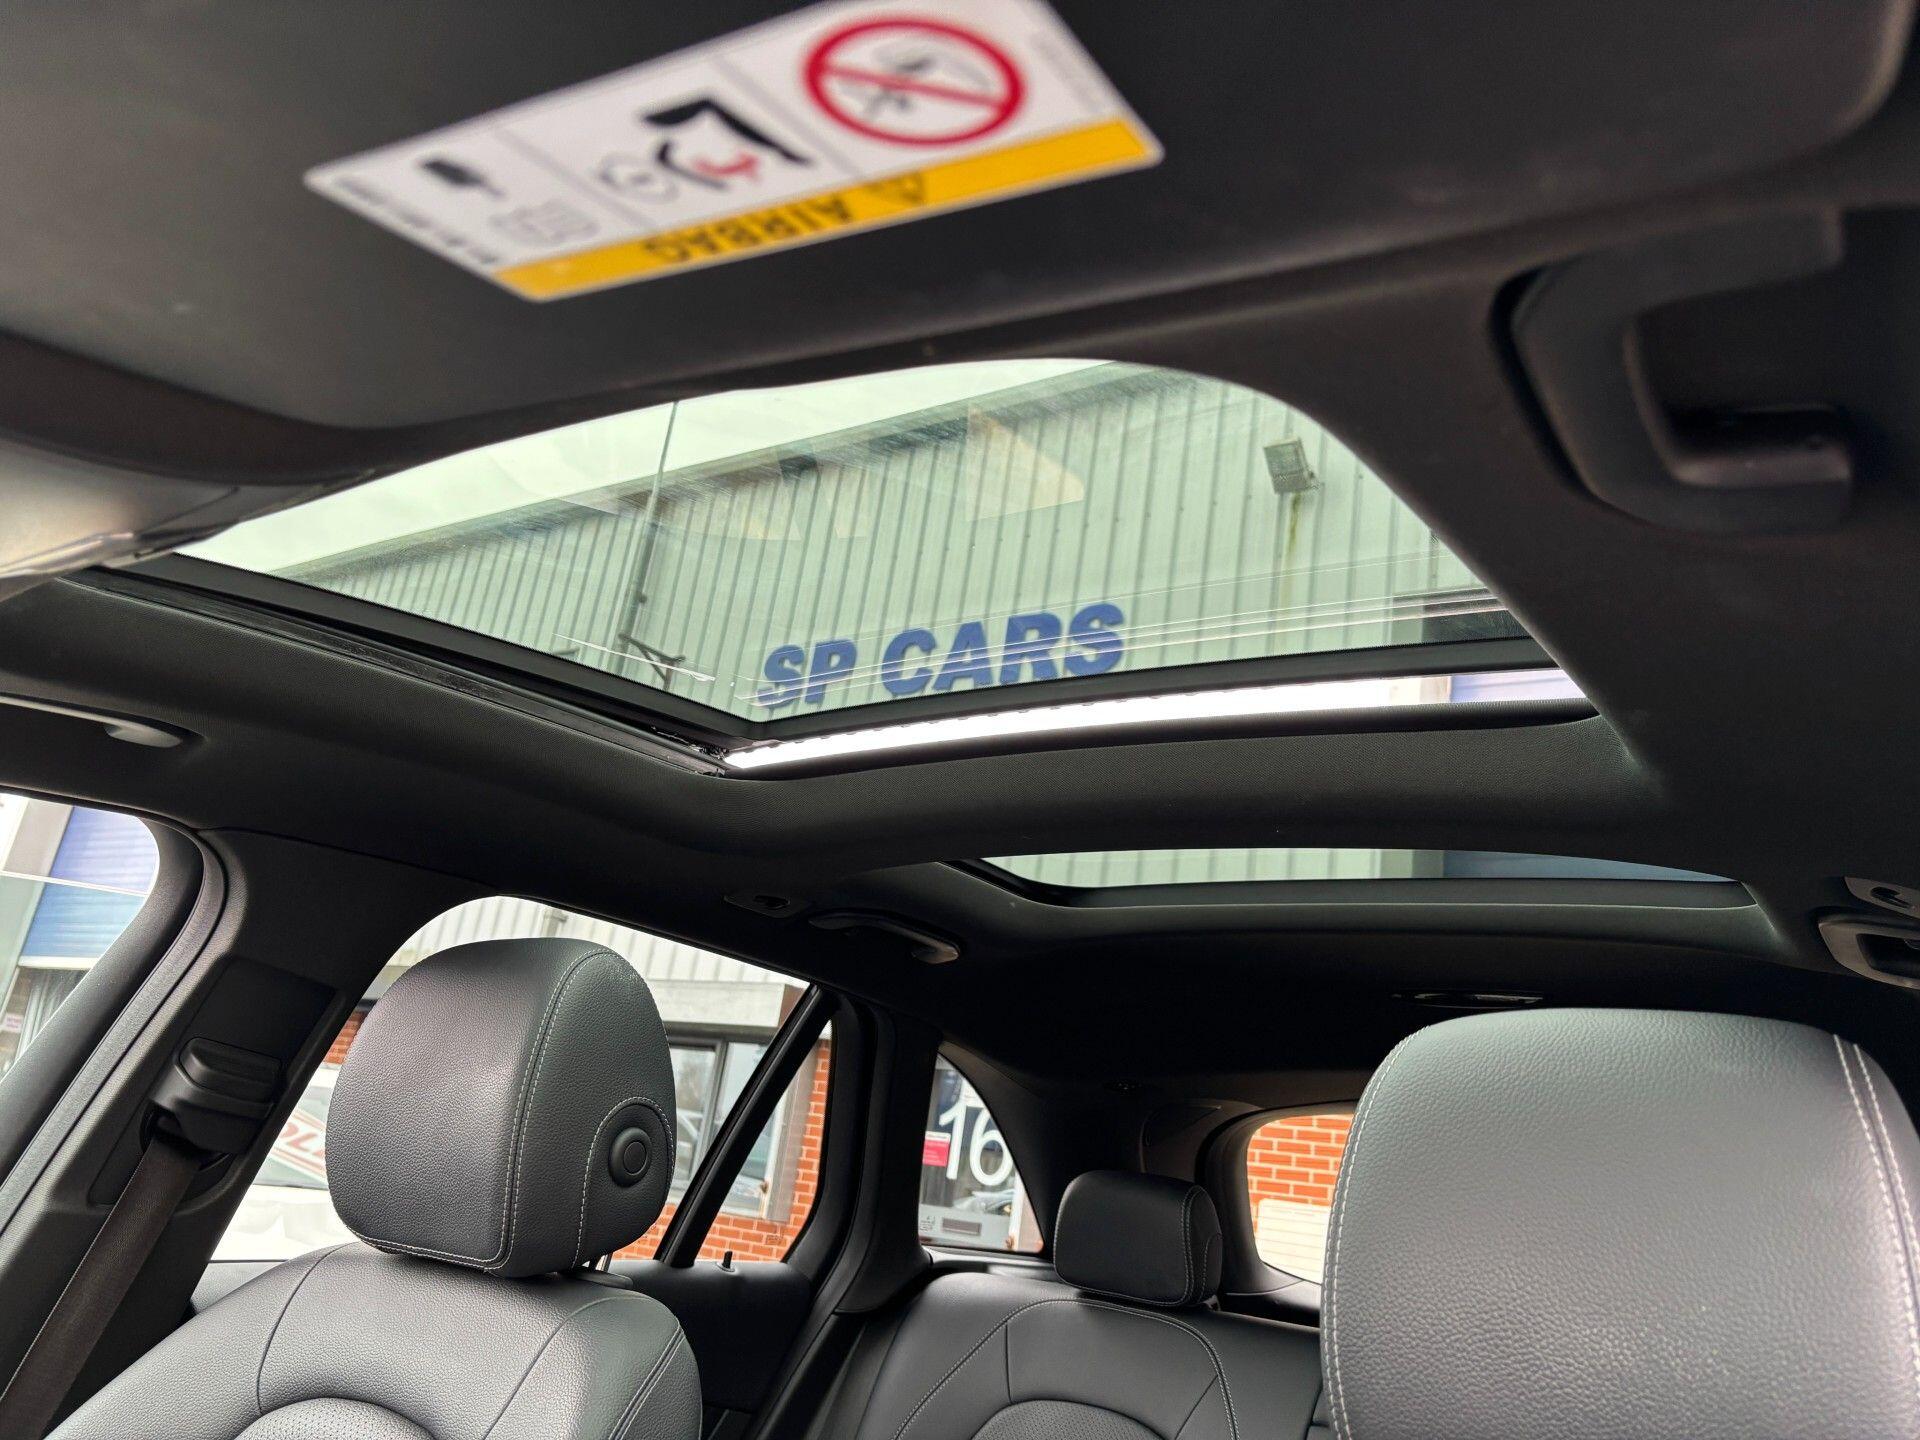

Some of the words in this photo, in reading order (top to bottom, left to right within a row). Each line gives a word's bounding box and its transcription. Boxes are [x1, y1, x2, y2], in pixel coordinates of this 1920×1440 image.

[645, 192, 851, 262] AIRBAG
[756, 637, 858, 710] SP
[881, 602, 1125, 697] CARS
[938, 1099, 1013, 1186] 16
